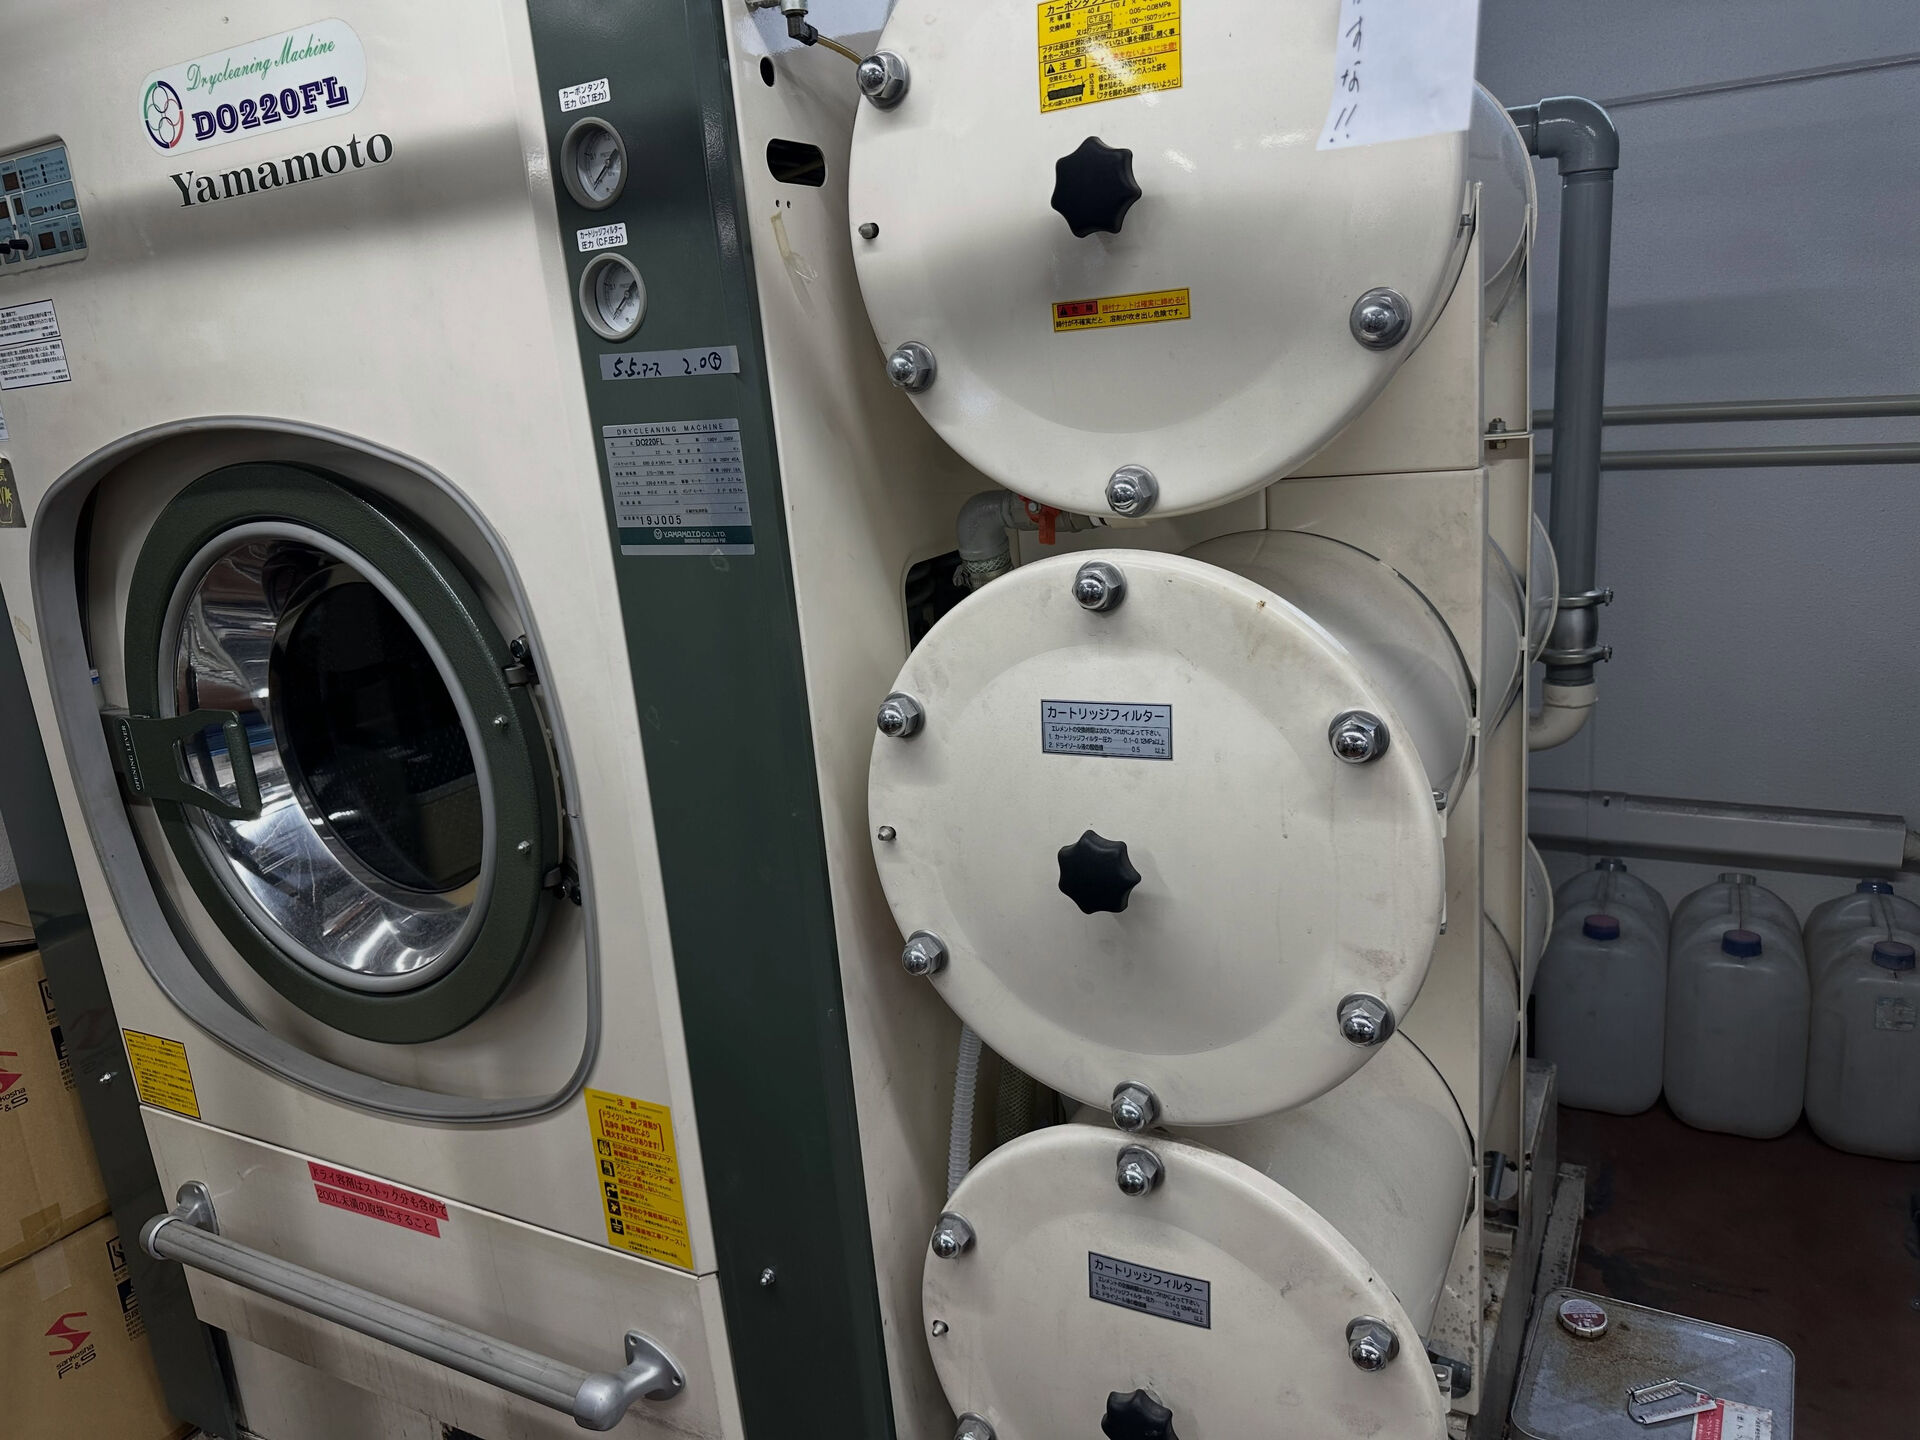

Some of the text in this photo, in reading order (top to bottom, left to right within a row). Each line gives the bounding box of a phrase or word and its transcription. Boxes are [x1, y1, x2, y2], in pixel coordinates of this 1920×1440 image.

[1049, 21, 1071, 33] 交換時期
[186, 33, 336, 95] Drycleaning Machine
[1059, 58, 1082, 71] 注意
[562, 80, 606, 99] カーボンタンク
[191, 75, 350, 142] DO220FL
[169, 133, 394, 208] Yamamoto
[579, 225, 623, 240] カートリッジフィルター
[616, 422, 724, 436] DRYCLEANING MACHINE
[635, 437, 665, 446] DO220FL
[640, 515, 682, 525] 19J005
[1047, 705, 1165, 723] カートリッジフィルター
[1094, 1259, 1204, 1293] カートリッジフィルター
[56, 1343, 95, 1370] sankosha
